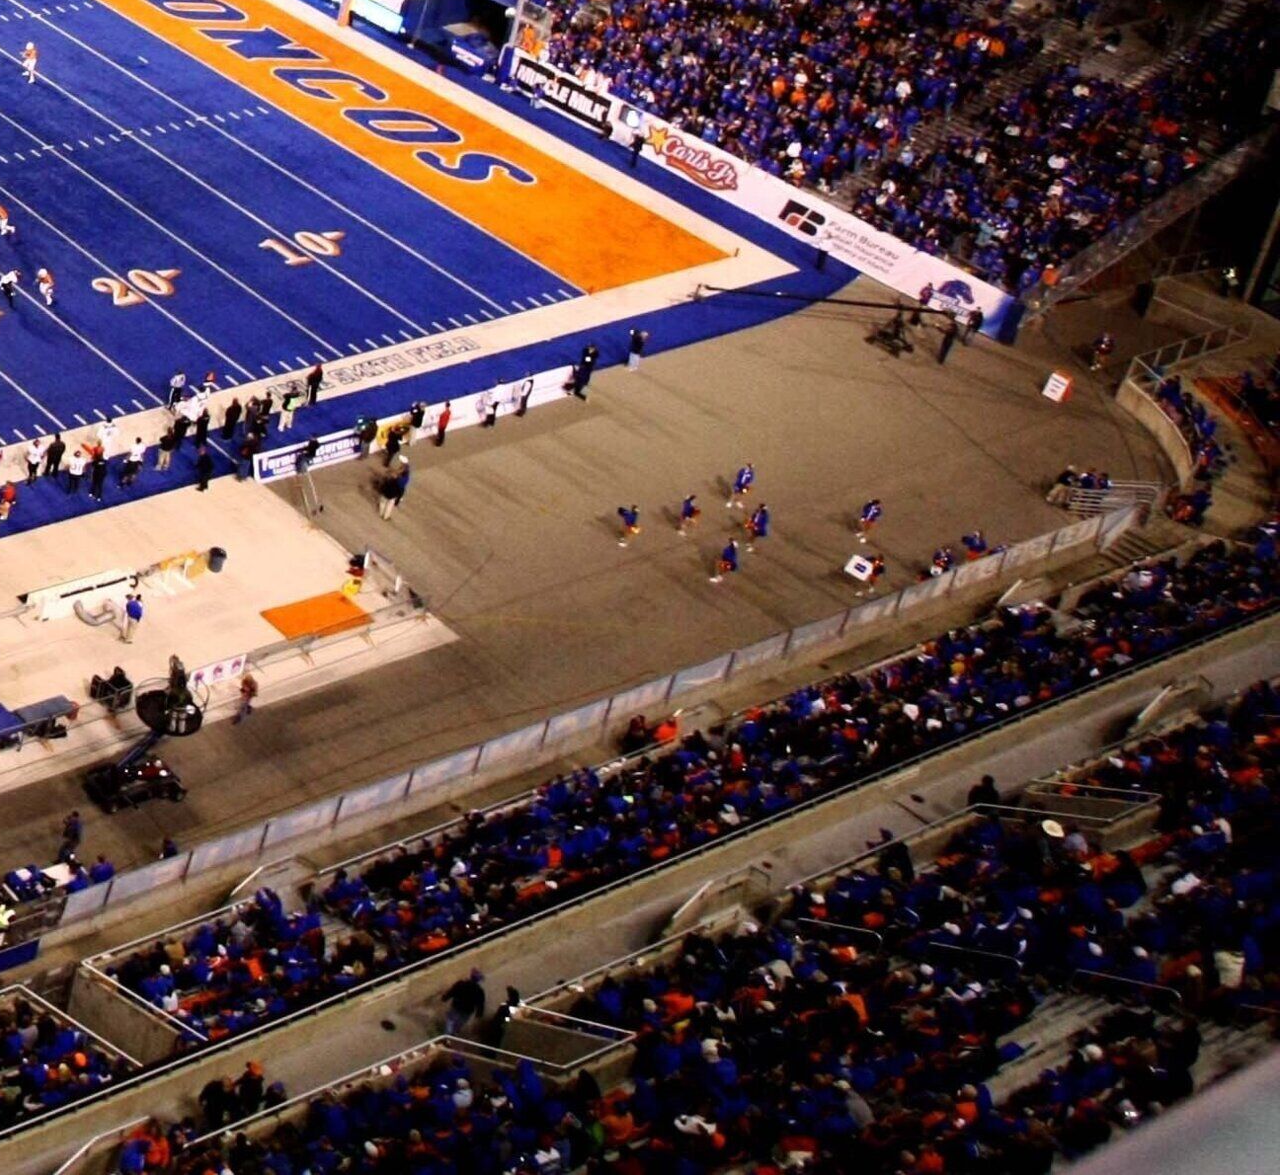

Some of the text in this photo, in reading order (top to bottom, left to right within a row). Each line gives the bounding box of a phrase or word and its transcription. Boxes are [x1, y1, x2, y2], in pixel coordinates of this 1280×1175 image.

[566, 87, 609, 122] MILK
[659, 136, 712, 174] Carl's
[257, 230, 342, 267] 10
[827, 221, 901, 260] Farm Bureau
[92, 269, 175, 308] 20
